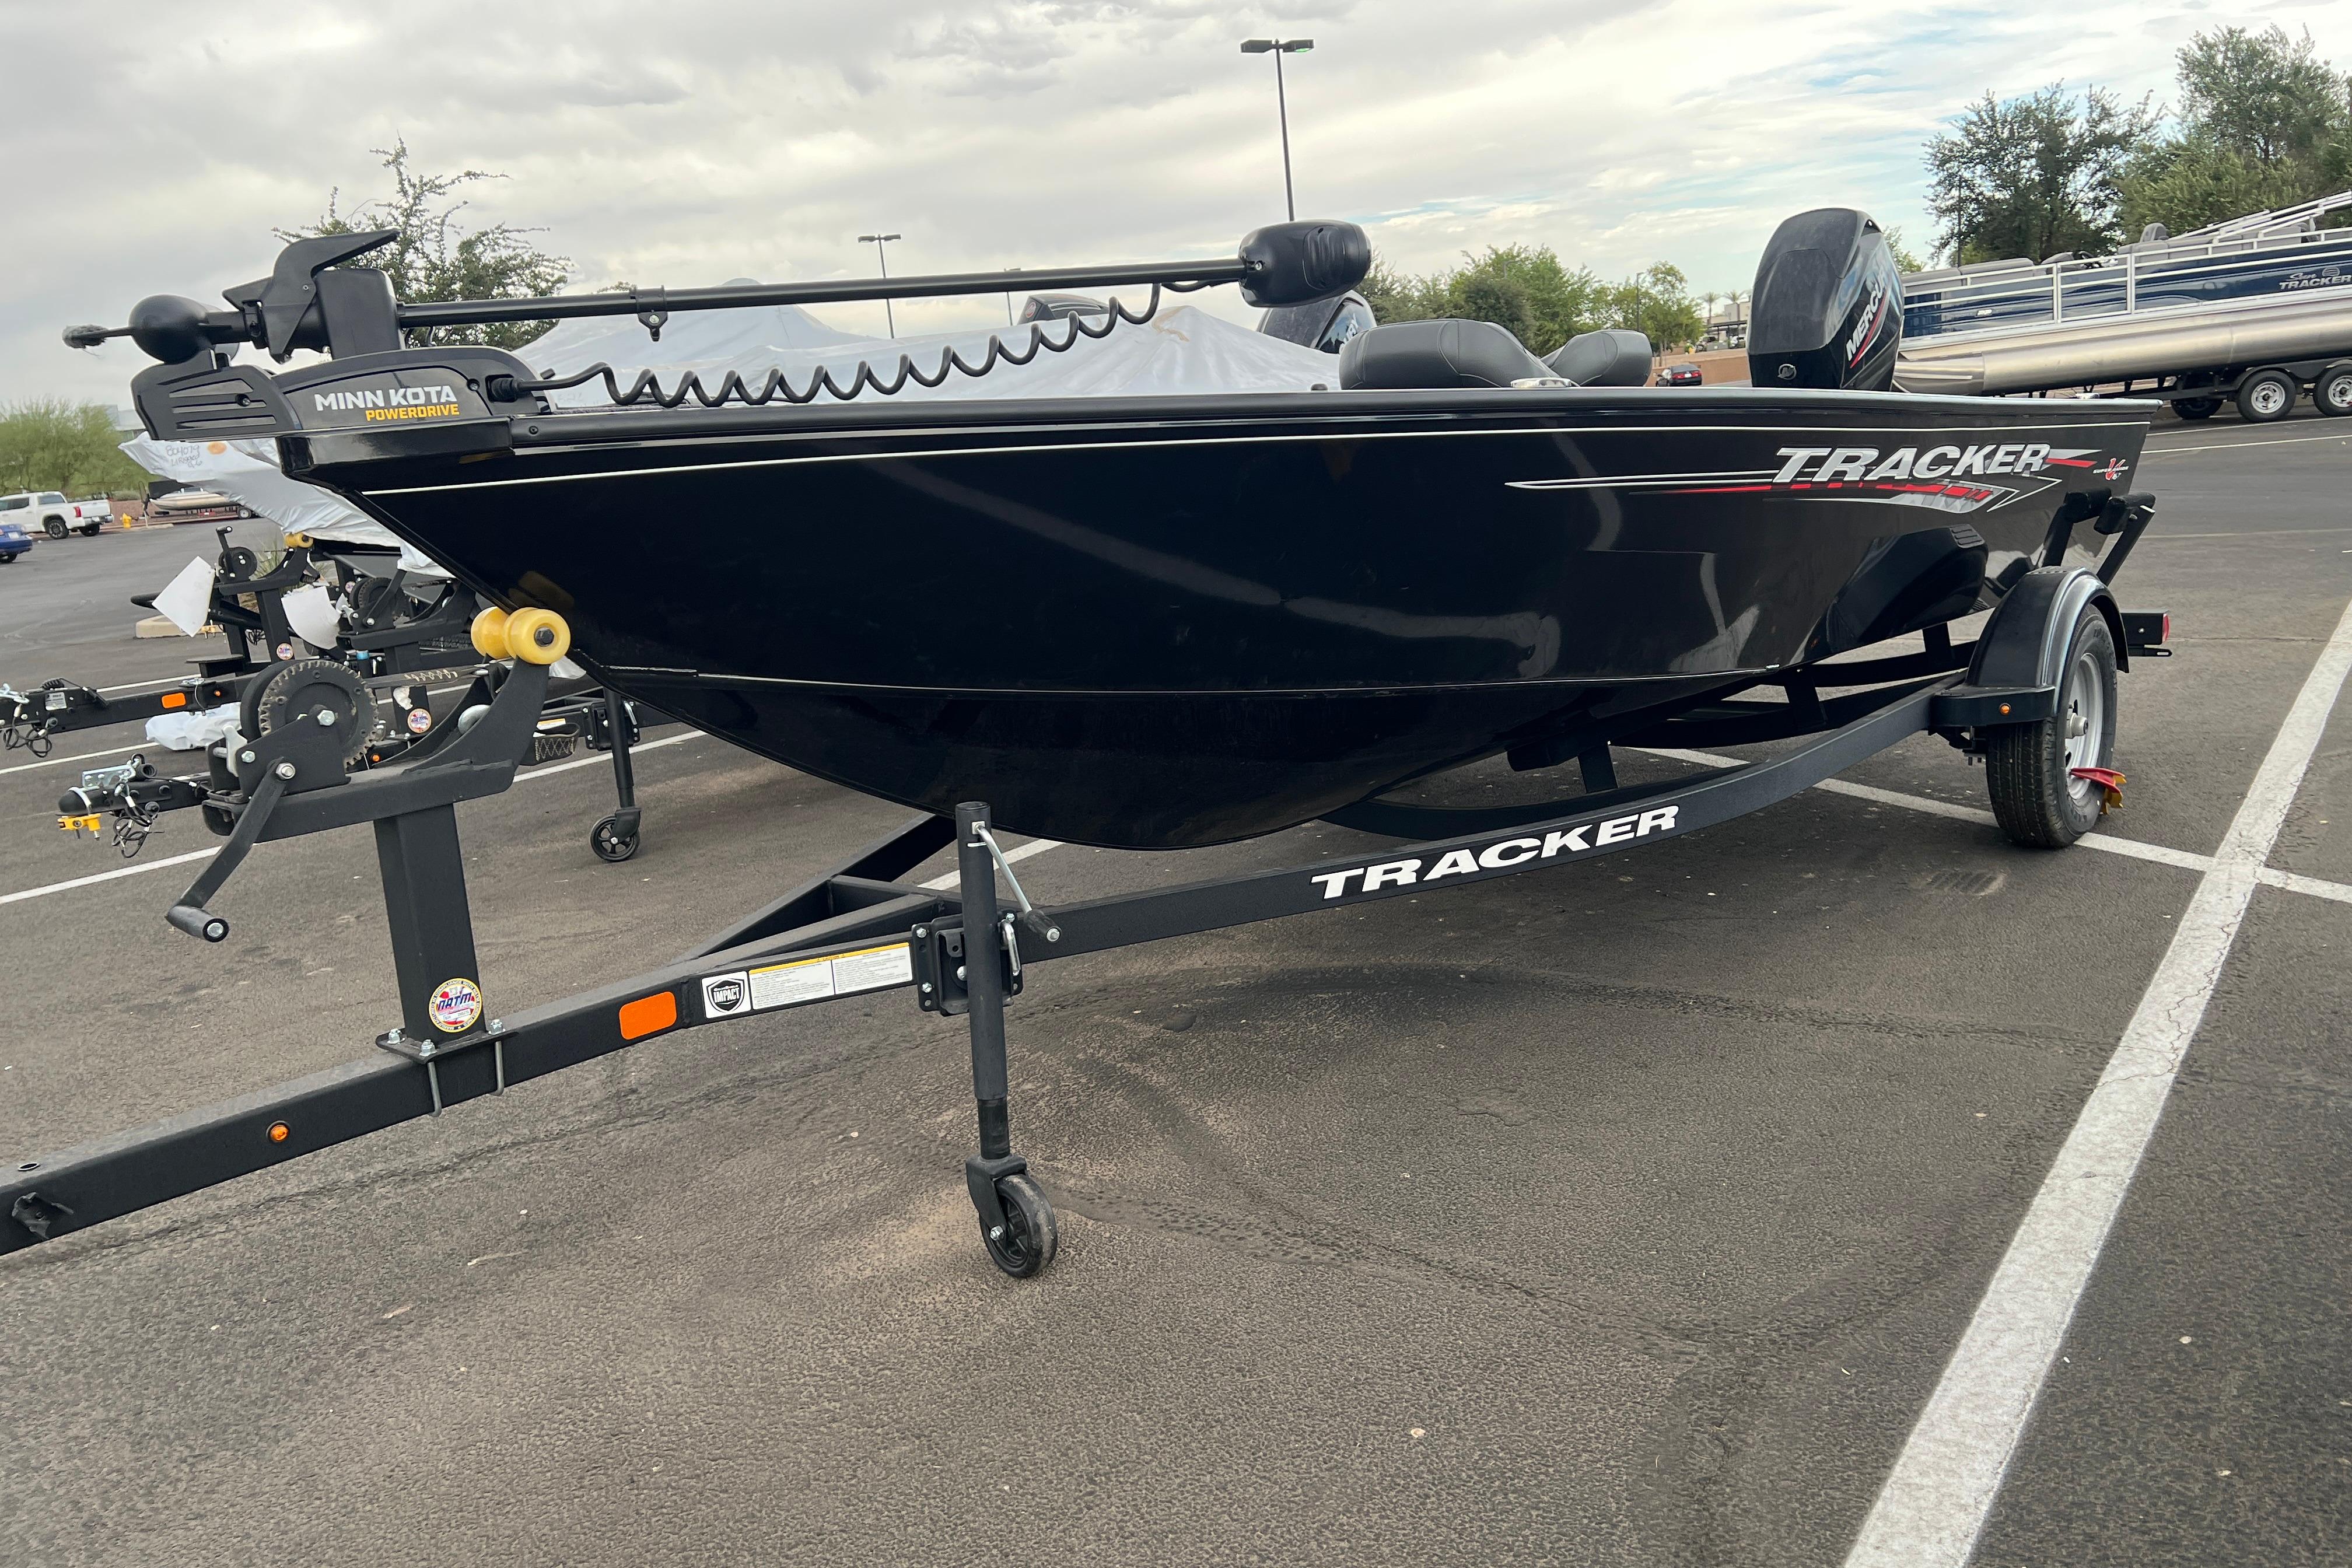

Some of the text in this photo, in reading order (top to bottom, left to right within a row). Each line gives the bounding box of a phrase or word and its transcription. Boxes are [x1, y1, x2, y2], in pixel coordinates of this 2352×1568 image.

[2278, 274, 2352, 290] TRACKER
[2286, 272, 2317, 282] Sun
[314, 385, 458, 411] MINN KOTA
[365, 404, 460, 421] POWERDRIVE
[1772, 443, 2051, 484] TRACKER
[1311, 805, 1680, 900] TRACKER
[713, 987, 740, 1003] IMPACT
